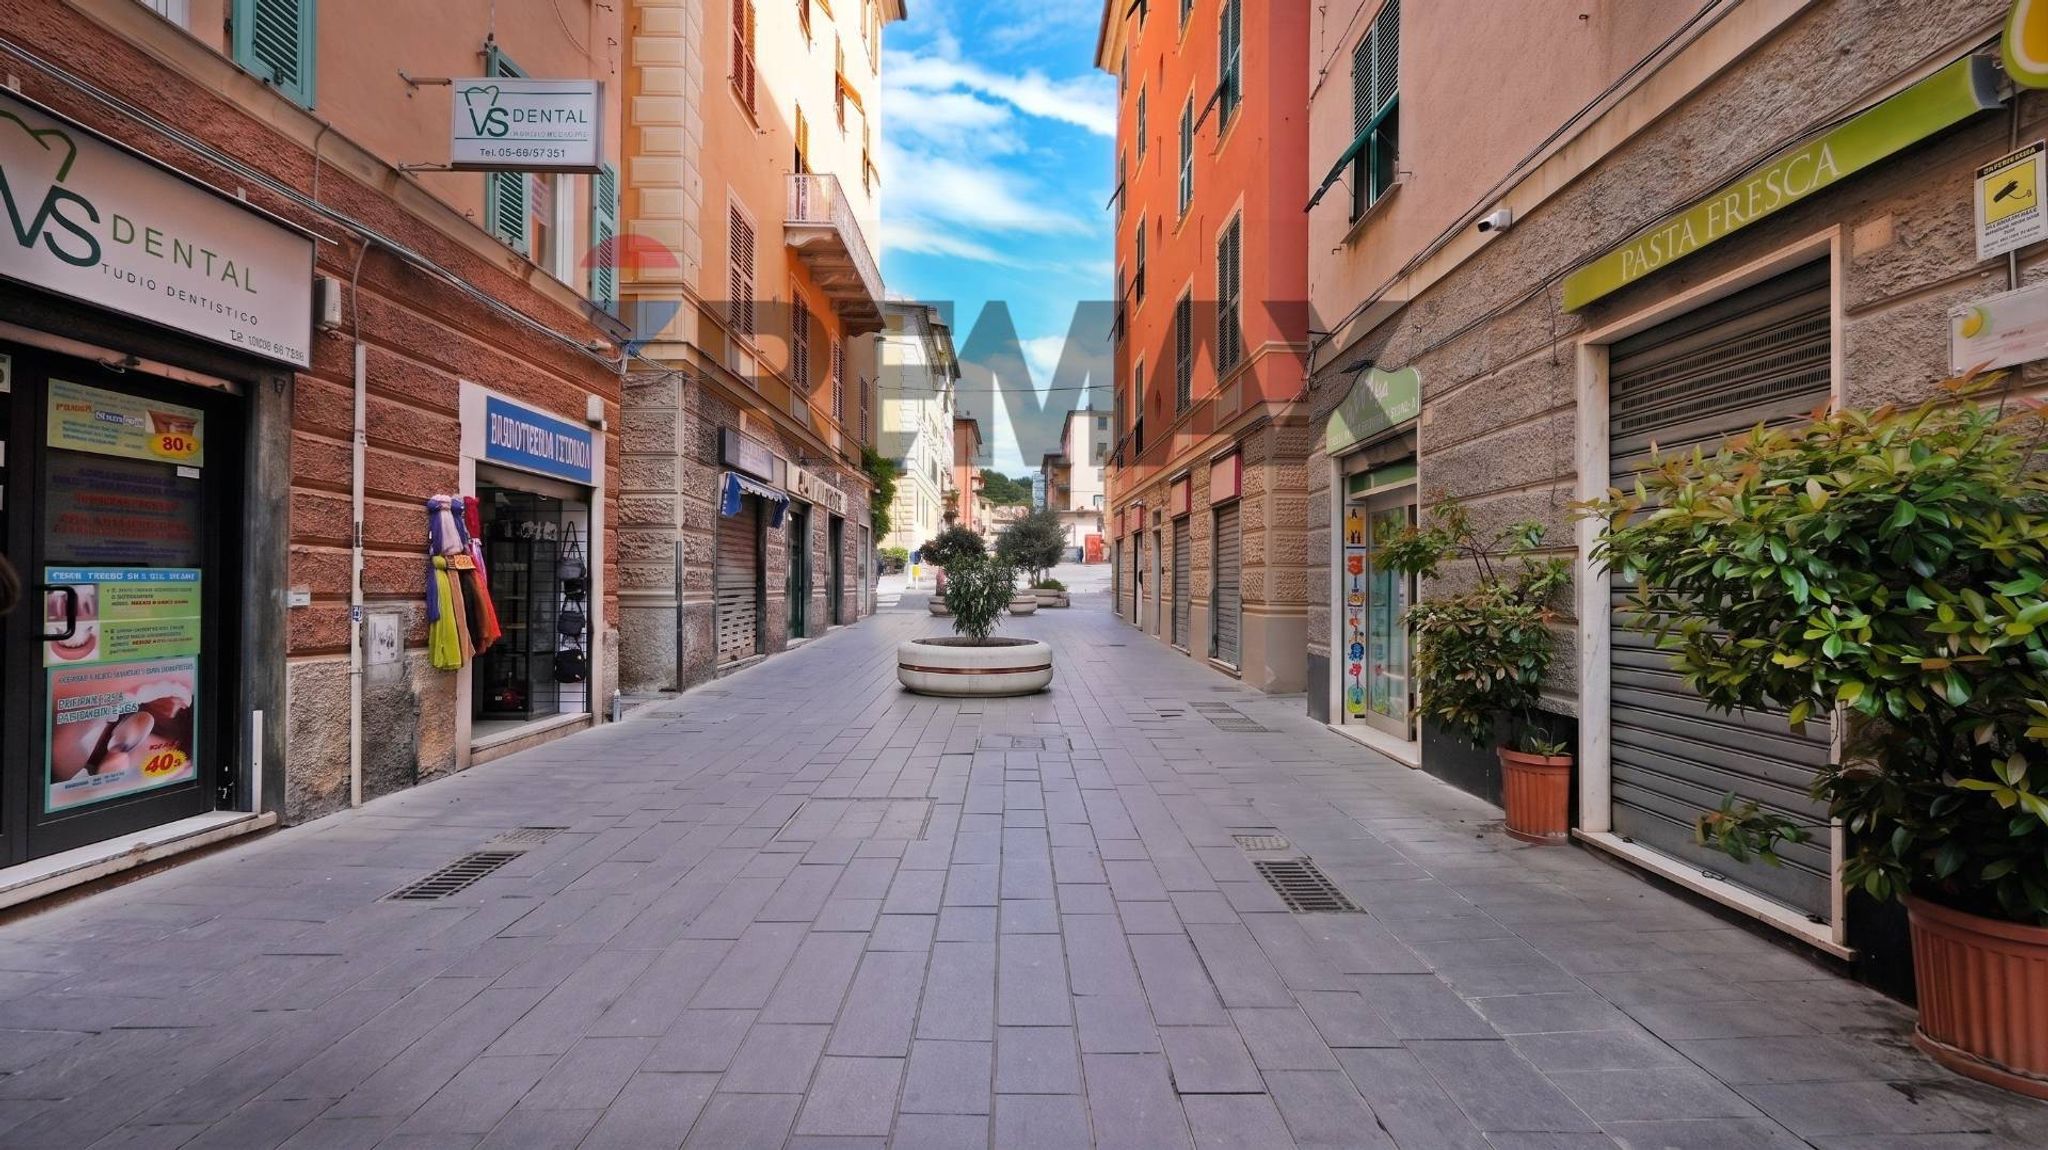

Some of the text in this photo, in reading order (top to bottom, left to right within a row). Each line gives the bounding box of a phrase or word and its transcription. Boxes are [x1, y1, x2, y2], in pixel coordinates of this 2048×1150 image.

[469, 108, 588, 137] VS DENTAL
[1620, 142, 1841, 281] PASTA FRESCA
[112, 213, 258, 294] DENTAL
[167, 285, 258, 326] DENTISTICO
[162, 436, 184, 452] 80
[145, 753, 174, 773] 40
